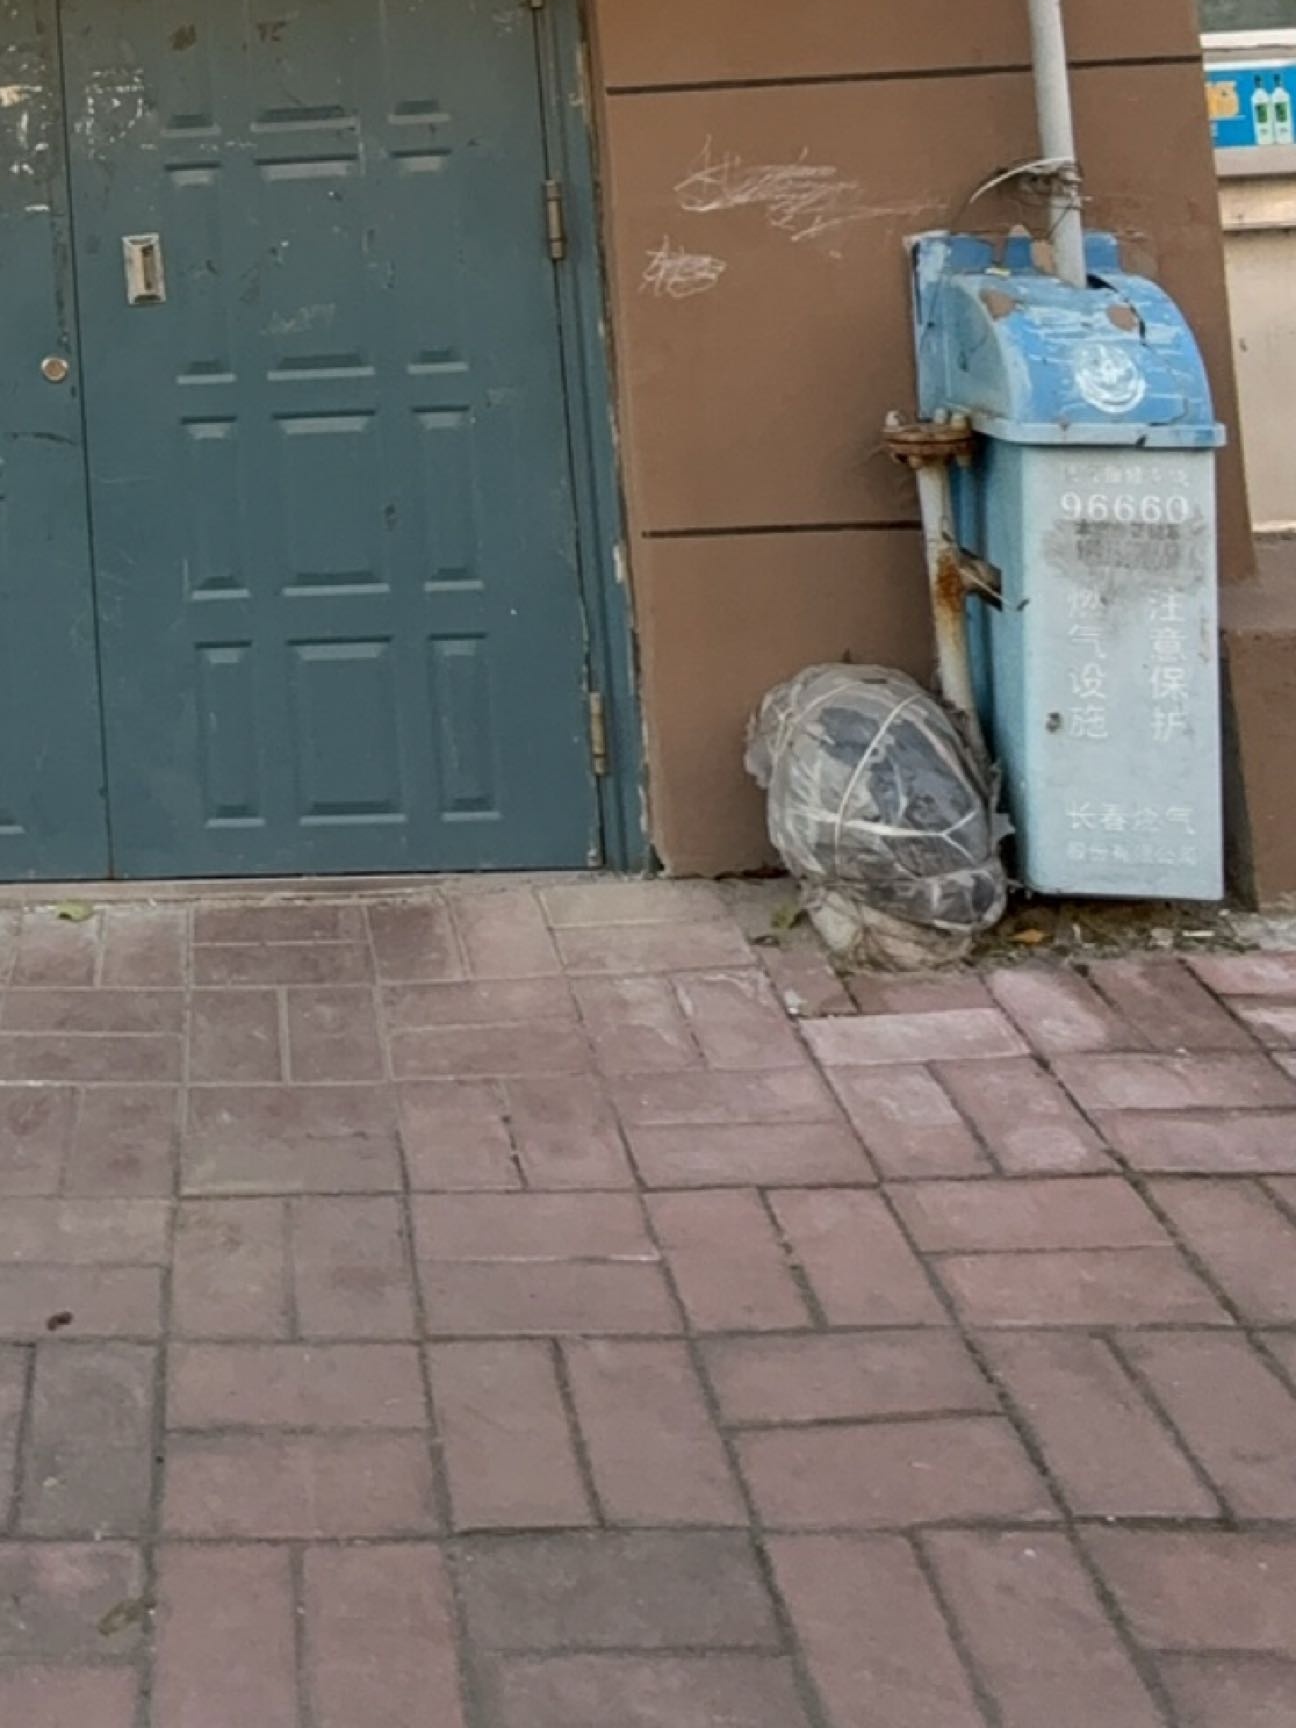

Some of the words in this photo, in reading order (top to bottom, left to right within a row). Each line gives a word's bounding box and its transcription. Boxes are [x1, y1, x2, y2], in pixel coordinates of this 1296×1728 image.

[1059, 490, 1191, 524] 96660
[1147, 586, 1190, 743] 注意保护
